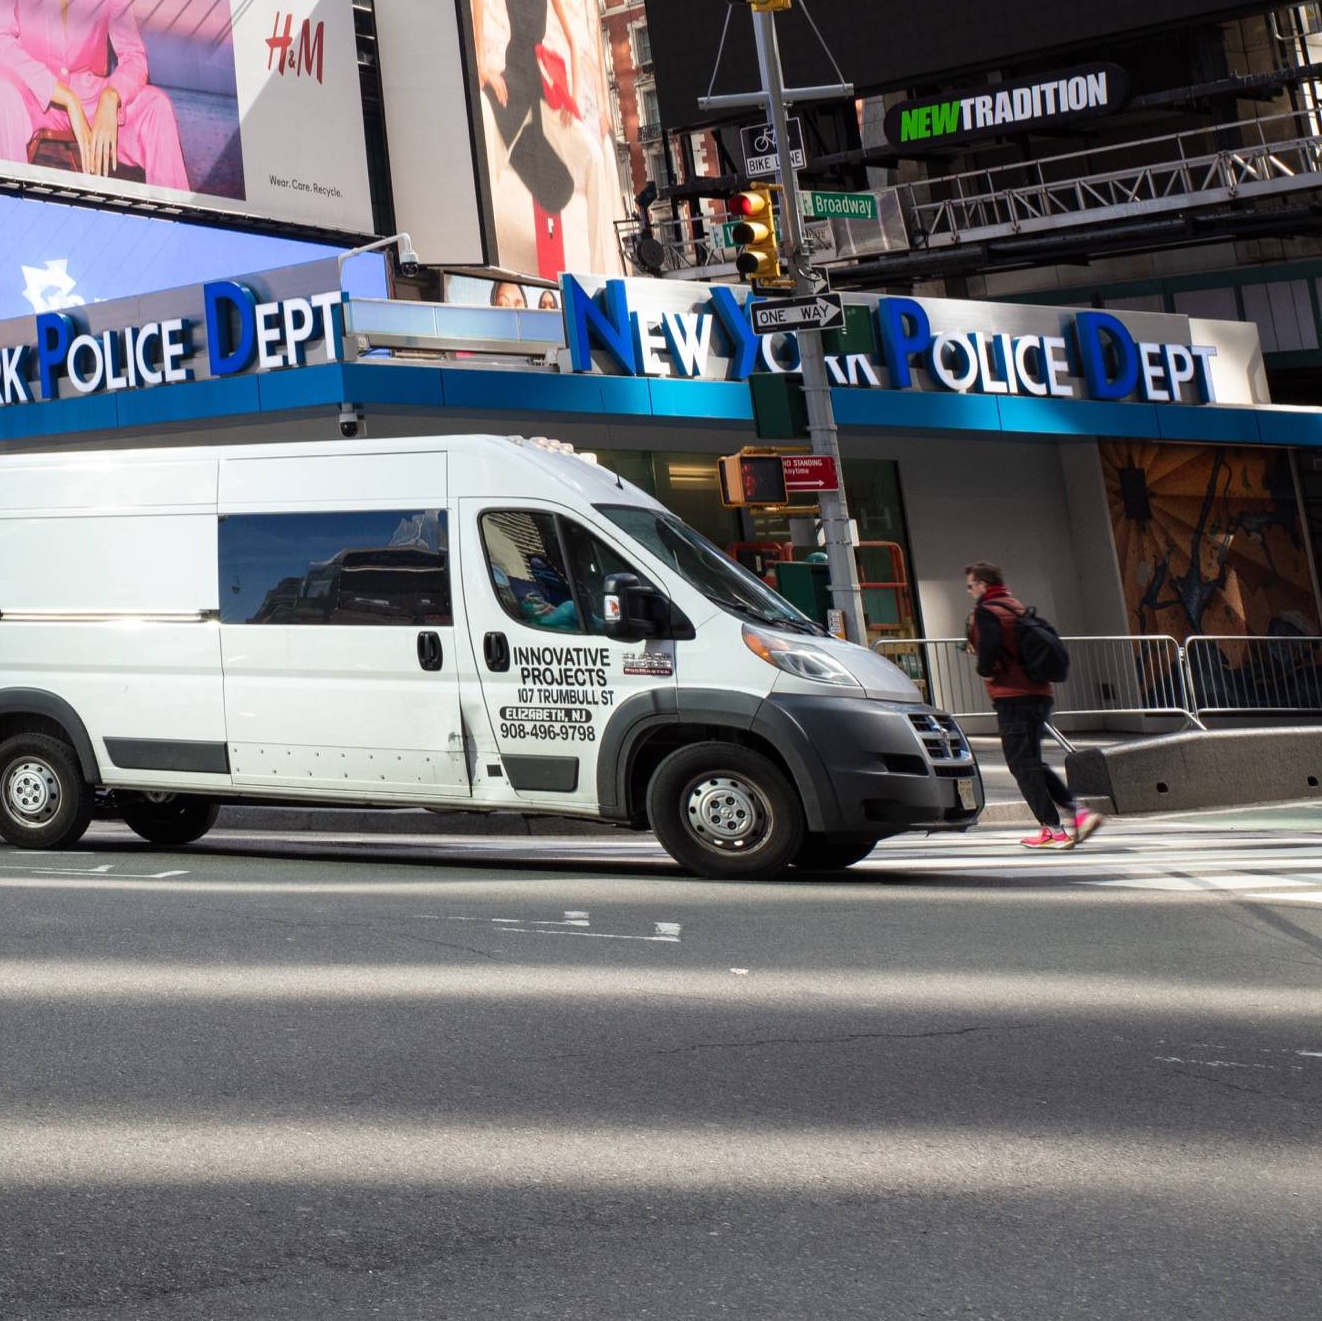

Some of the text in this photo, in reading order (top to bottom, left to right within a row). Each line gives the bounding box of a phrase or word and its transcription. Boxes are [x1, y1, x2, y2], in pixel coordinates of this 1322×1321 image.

[265, 11, 324, 85] H&M
[749, 152, 802, 172] BIKE LNE
[269, 175, 343, 198] Wear. Care. Recycle.
[815, 195, 872, 218] Broadway
[760, 305, 829, 324] ONE WAY
[36, 312, 194, 399] POLICE
[204, 280, 346, 375] DEPT
[562, 273, 713, 376] NEW
[878, 297, 1073, 397] POLICE
[1076, 311, 1217, 403] DEPT
[793, 459, 823, 467] STANDING
[513, 646, 611, 667] INNOVATIVE
[521, 667, 607, 687] PROJECTS
[518, 688, 614, 706] 107 TRUMBULL ST
[571, 709, 587, 722] NJ
[500, 723, 596, 742] 908-496-9798
